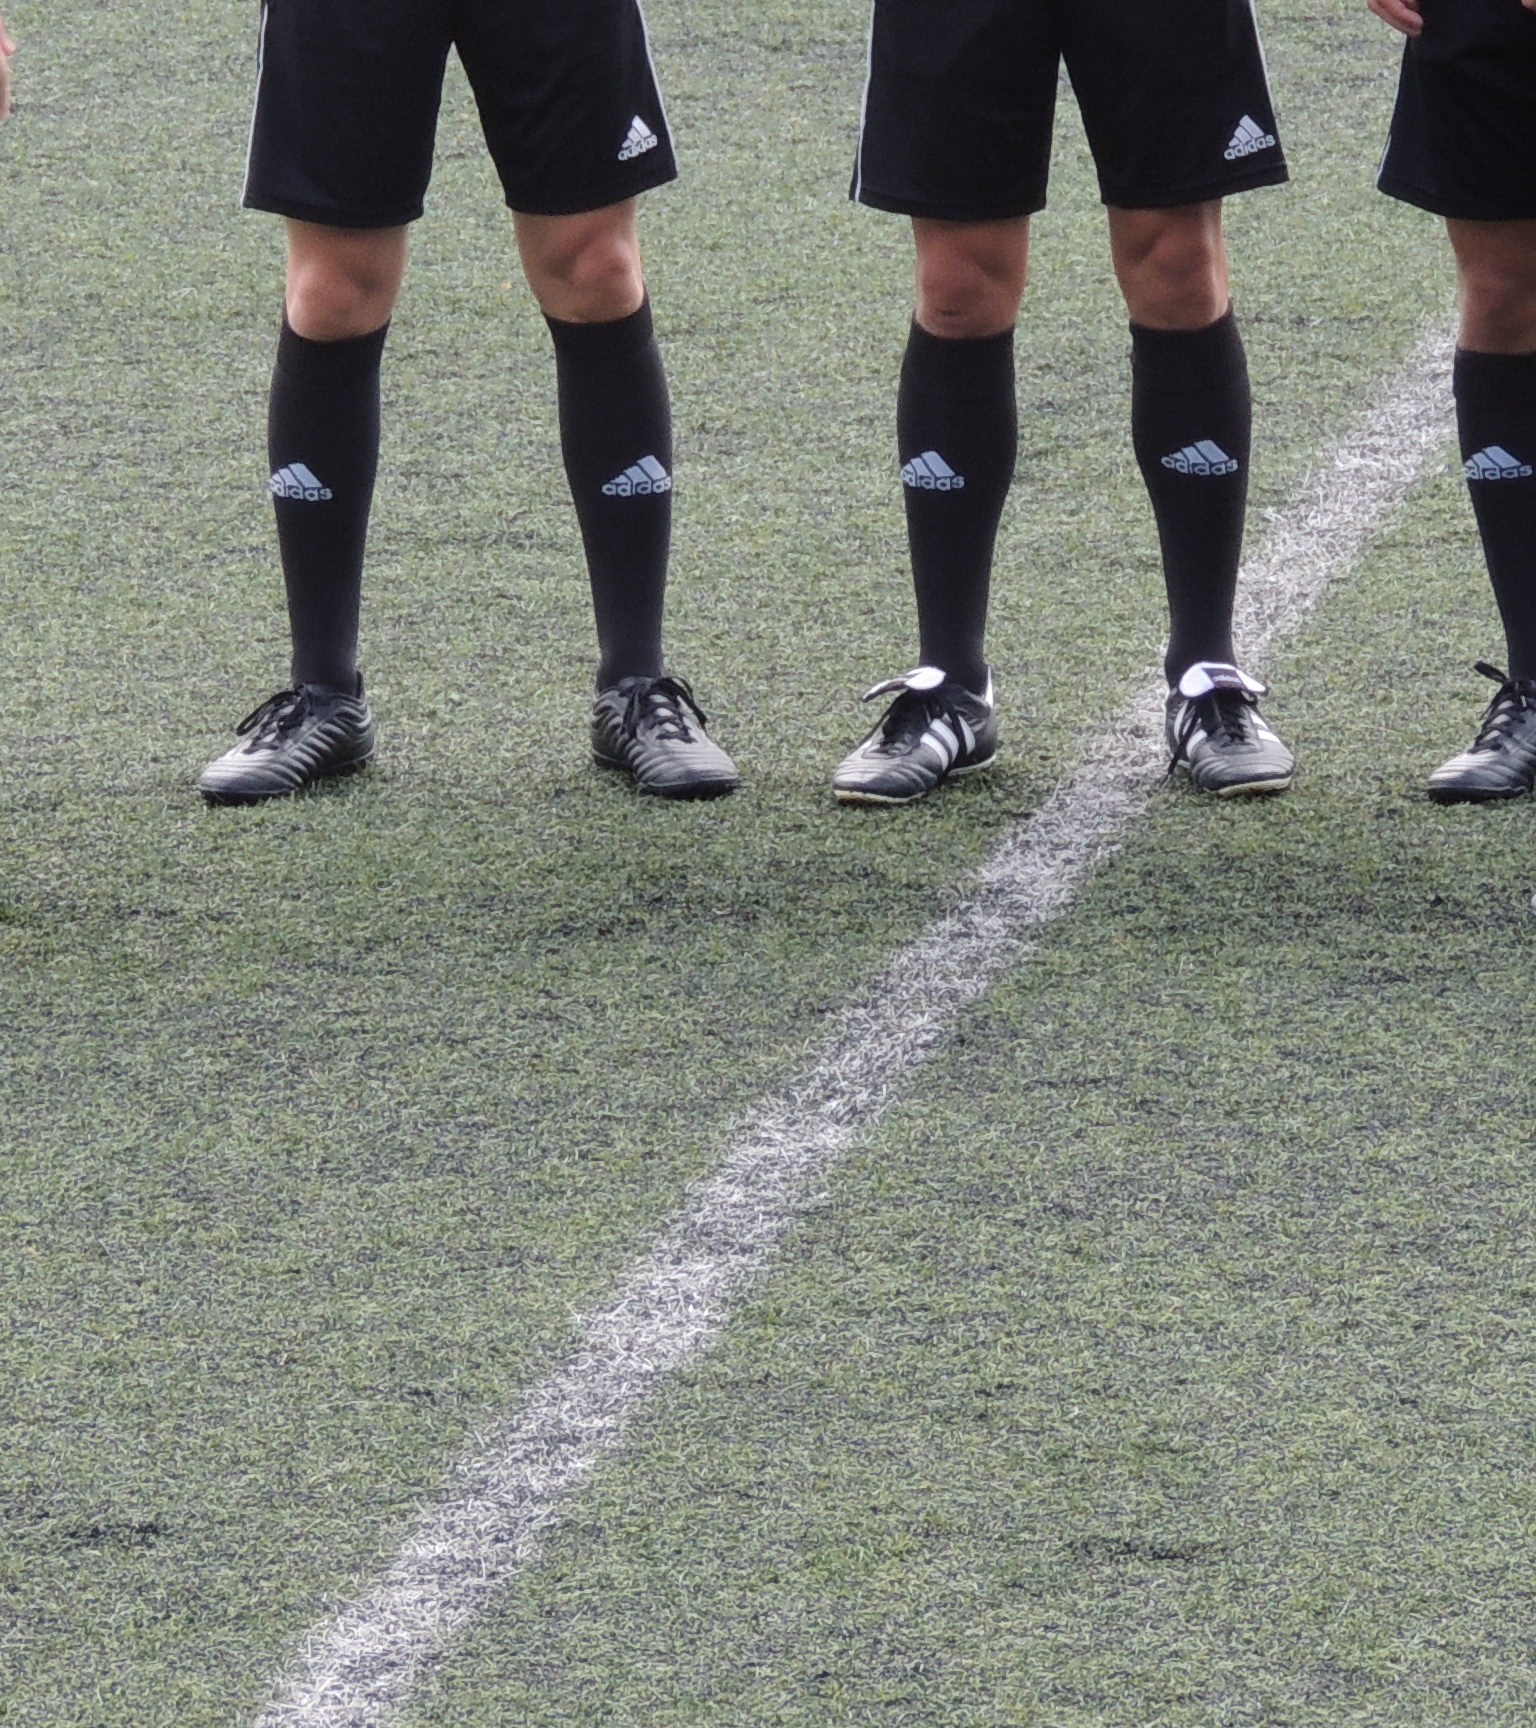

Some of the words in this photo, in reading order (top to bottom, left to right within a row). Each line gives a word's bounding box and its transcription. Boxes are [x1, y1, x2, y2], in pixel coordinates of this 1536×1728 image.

[617, 134, 658, 161] adidas
[1224, 134, 1276, 161] adidas
[1160, 456, 1239, 476] adidas
[601, 475, 672, 497] adidas
